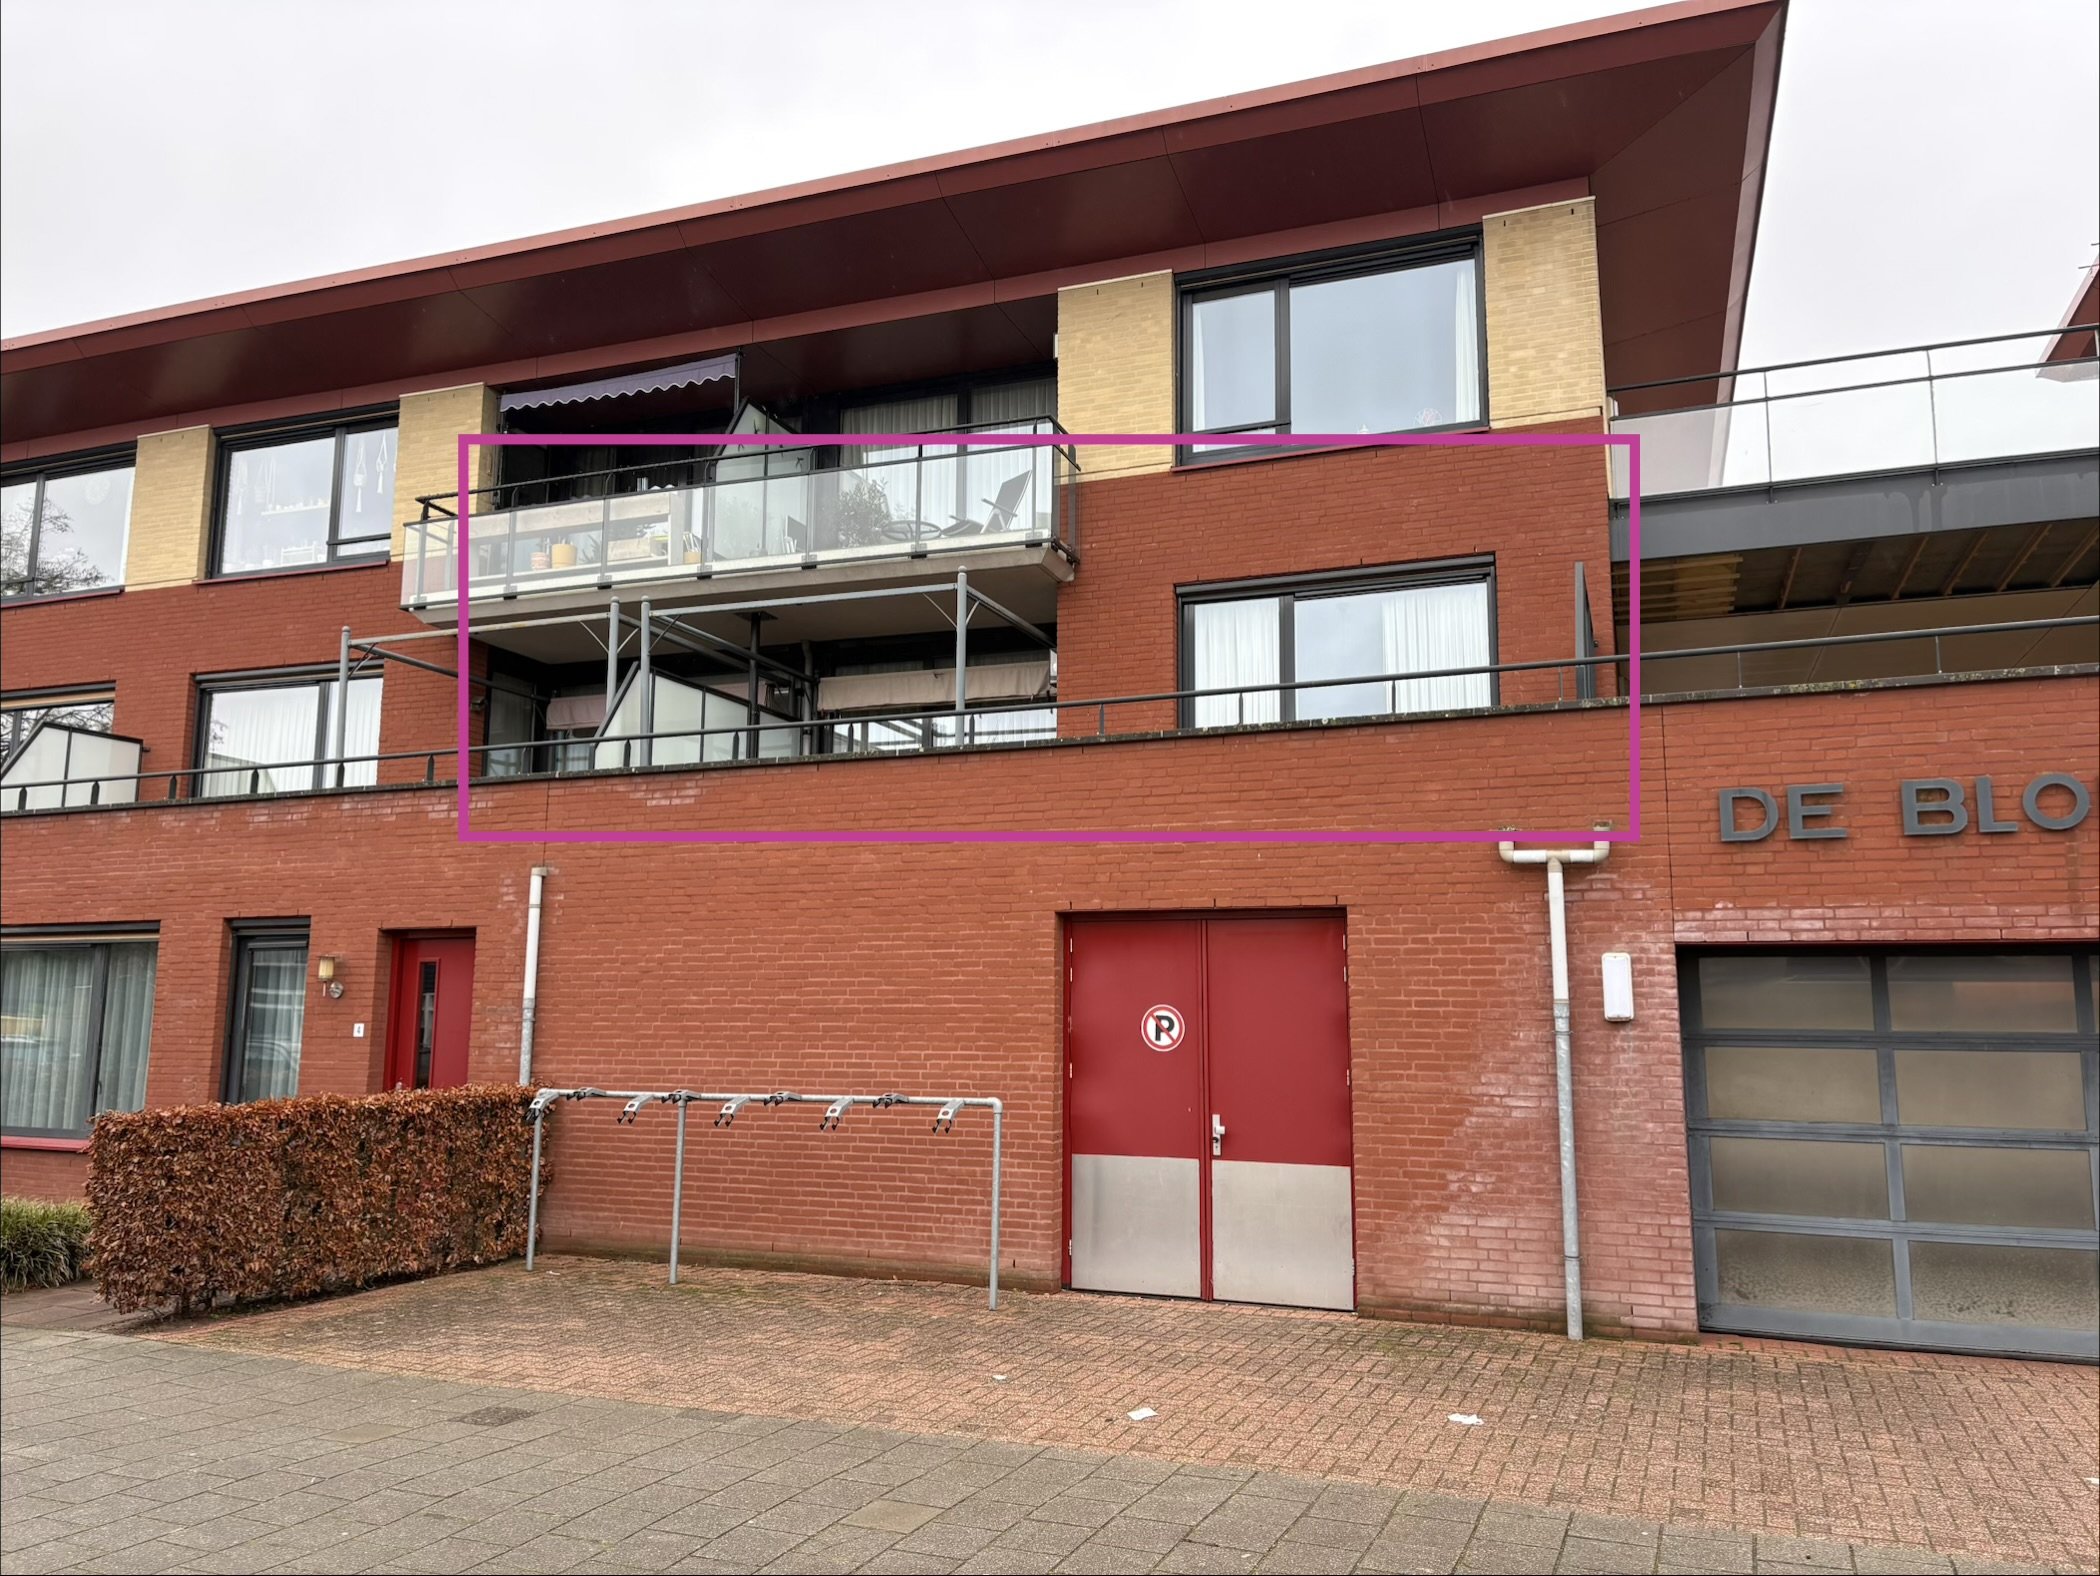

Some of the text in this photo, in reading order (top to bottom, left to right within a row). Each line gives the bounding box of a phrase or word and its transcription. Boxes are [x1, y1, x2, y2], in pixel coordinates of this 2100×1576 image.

[1718, 772, 2091, 842] DE BLO
[1155, 1015, 1175, 1041] P
